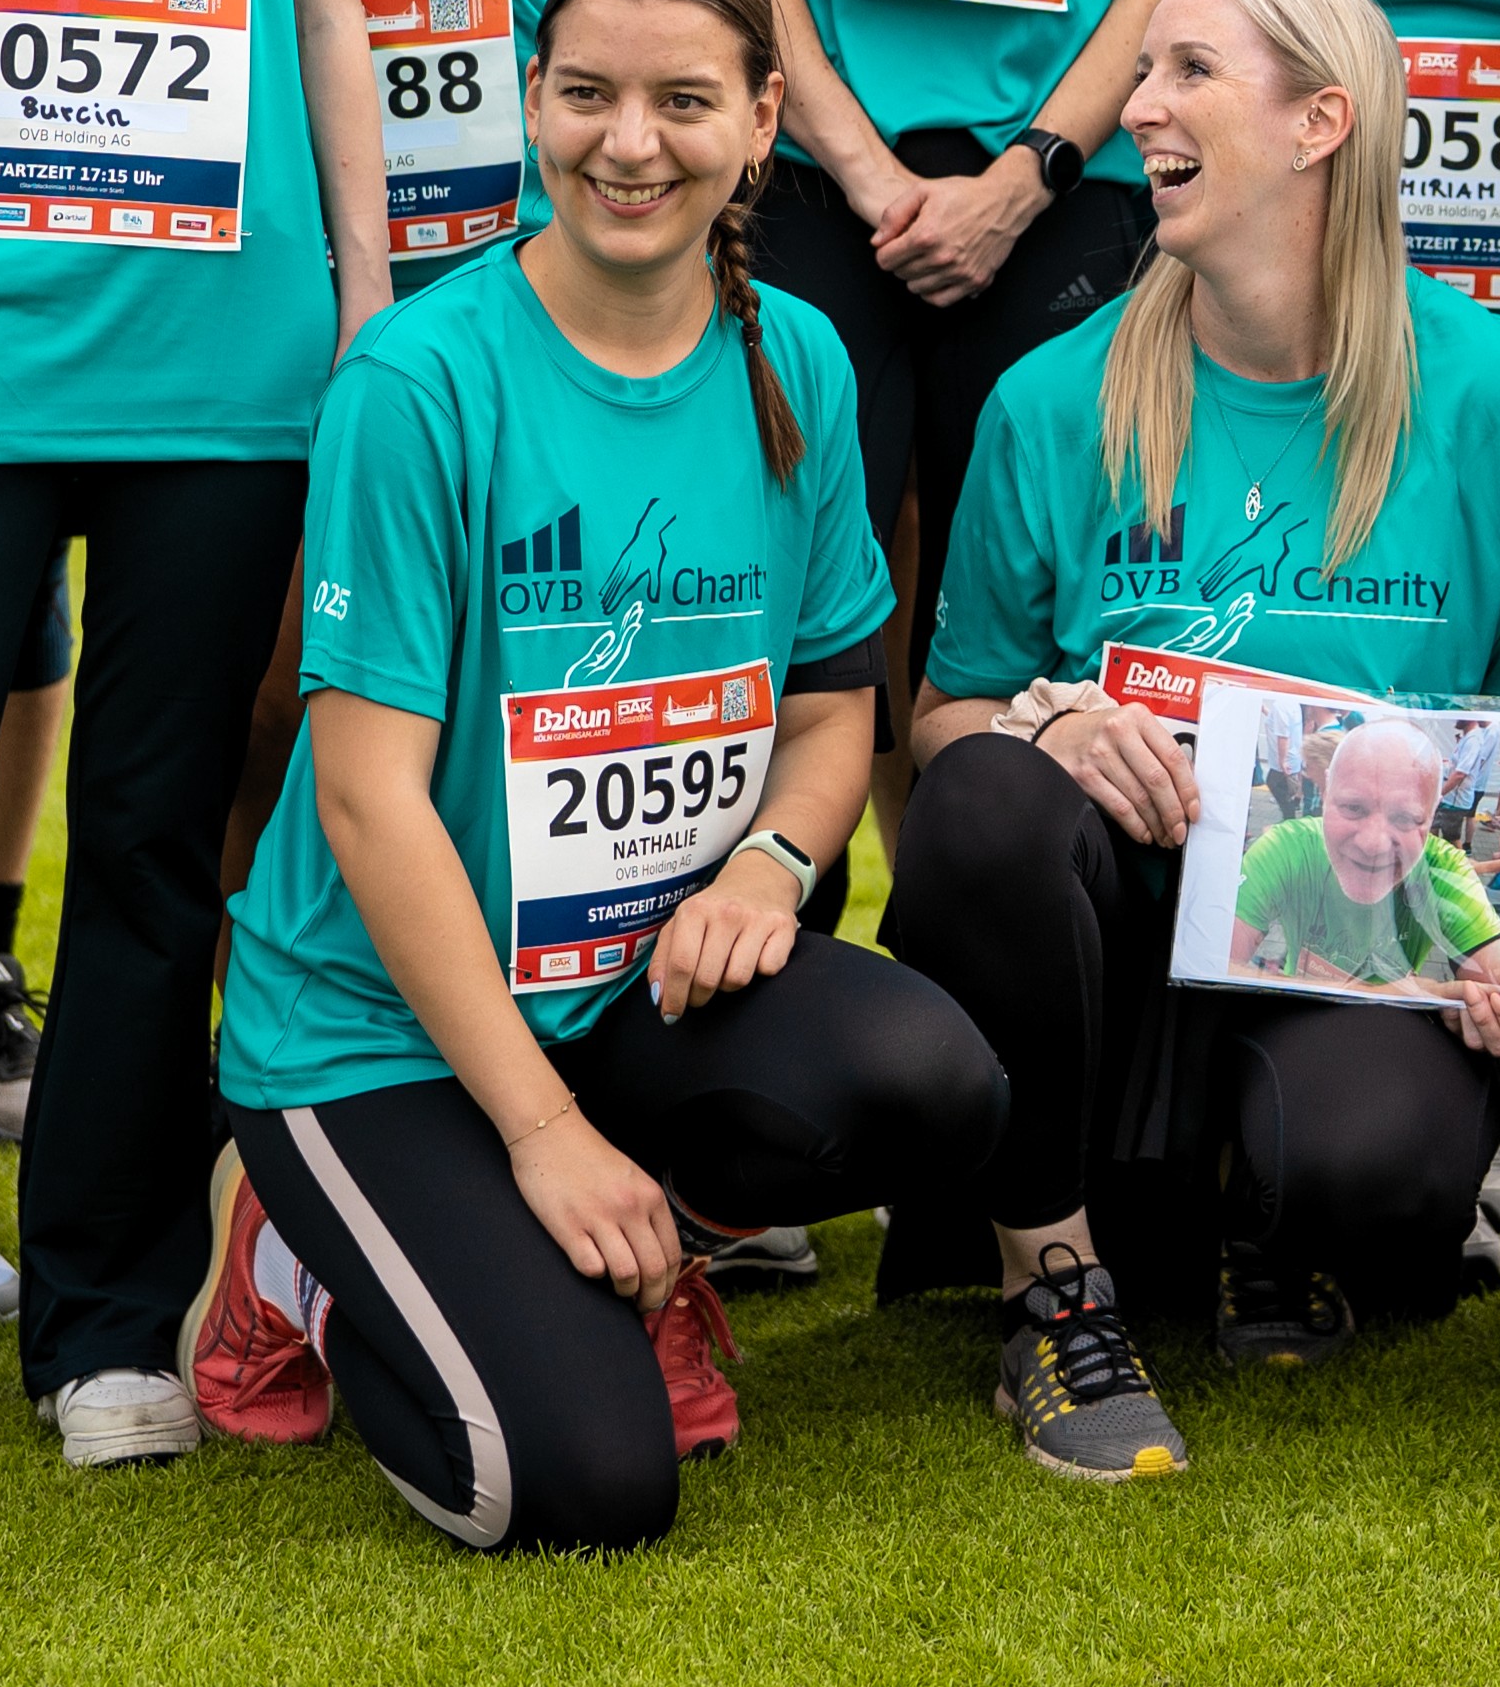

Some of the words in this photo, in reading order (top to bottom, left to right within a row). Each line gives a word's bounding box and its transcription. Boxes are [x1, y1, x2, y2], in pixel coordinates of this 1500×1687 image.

[387, 51, 482, 119] 88
[21, 96, 130, 127] Burcin
[19, 128, 49, 142] OVB
[54, 129, 106, 147] Holding
[111, 133, 131, 147] AG
[80, 167, 128, 183] 17:15
[134, 170, 164, 186] Uhr
[1400, 179, 1496, 200] MIRIAM
[422, 184, 451, 201] Uhr
[1407, 204, 1434, 216] OVB
[1439, 205, 1486, 220] Holding
[500, 580, 583, 614] OVB
[1101, 569, 1180, 601] OVB
[1293, 566, 1450, 616] Charity
[1125, 662, 1196, 695] B2Run
[533, 705, 611, 732] B2Run
[618, 697, 653, 714] DAK
[618, 710, 654, 724] Gesundheit
[547, 742, 748, 837] 20595
[613, 827, 698, 860] NATHALIE
[616, 866, 638, 881] OVB
[642, 859, 678, 878] Holding
[679, 854, 692, 867] AG
[588, 897, 654, 923] STARTZEIT
[658, 888, 684, 910] 17:15
